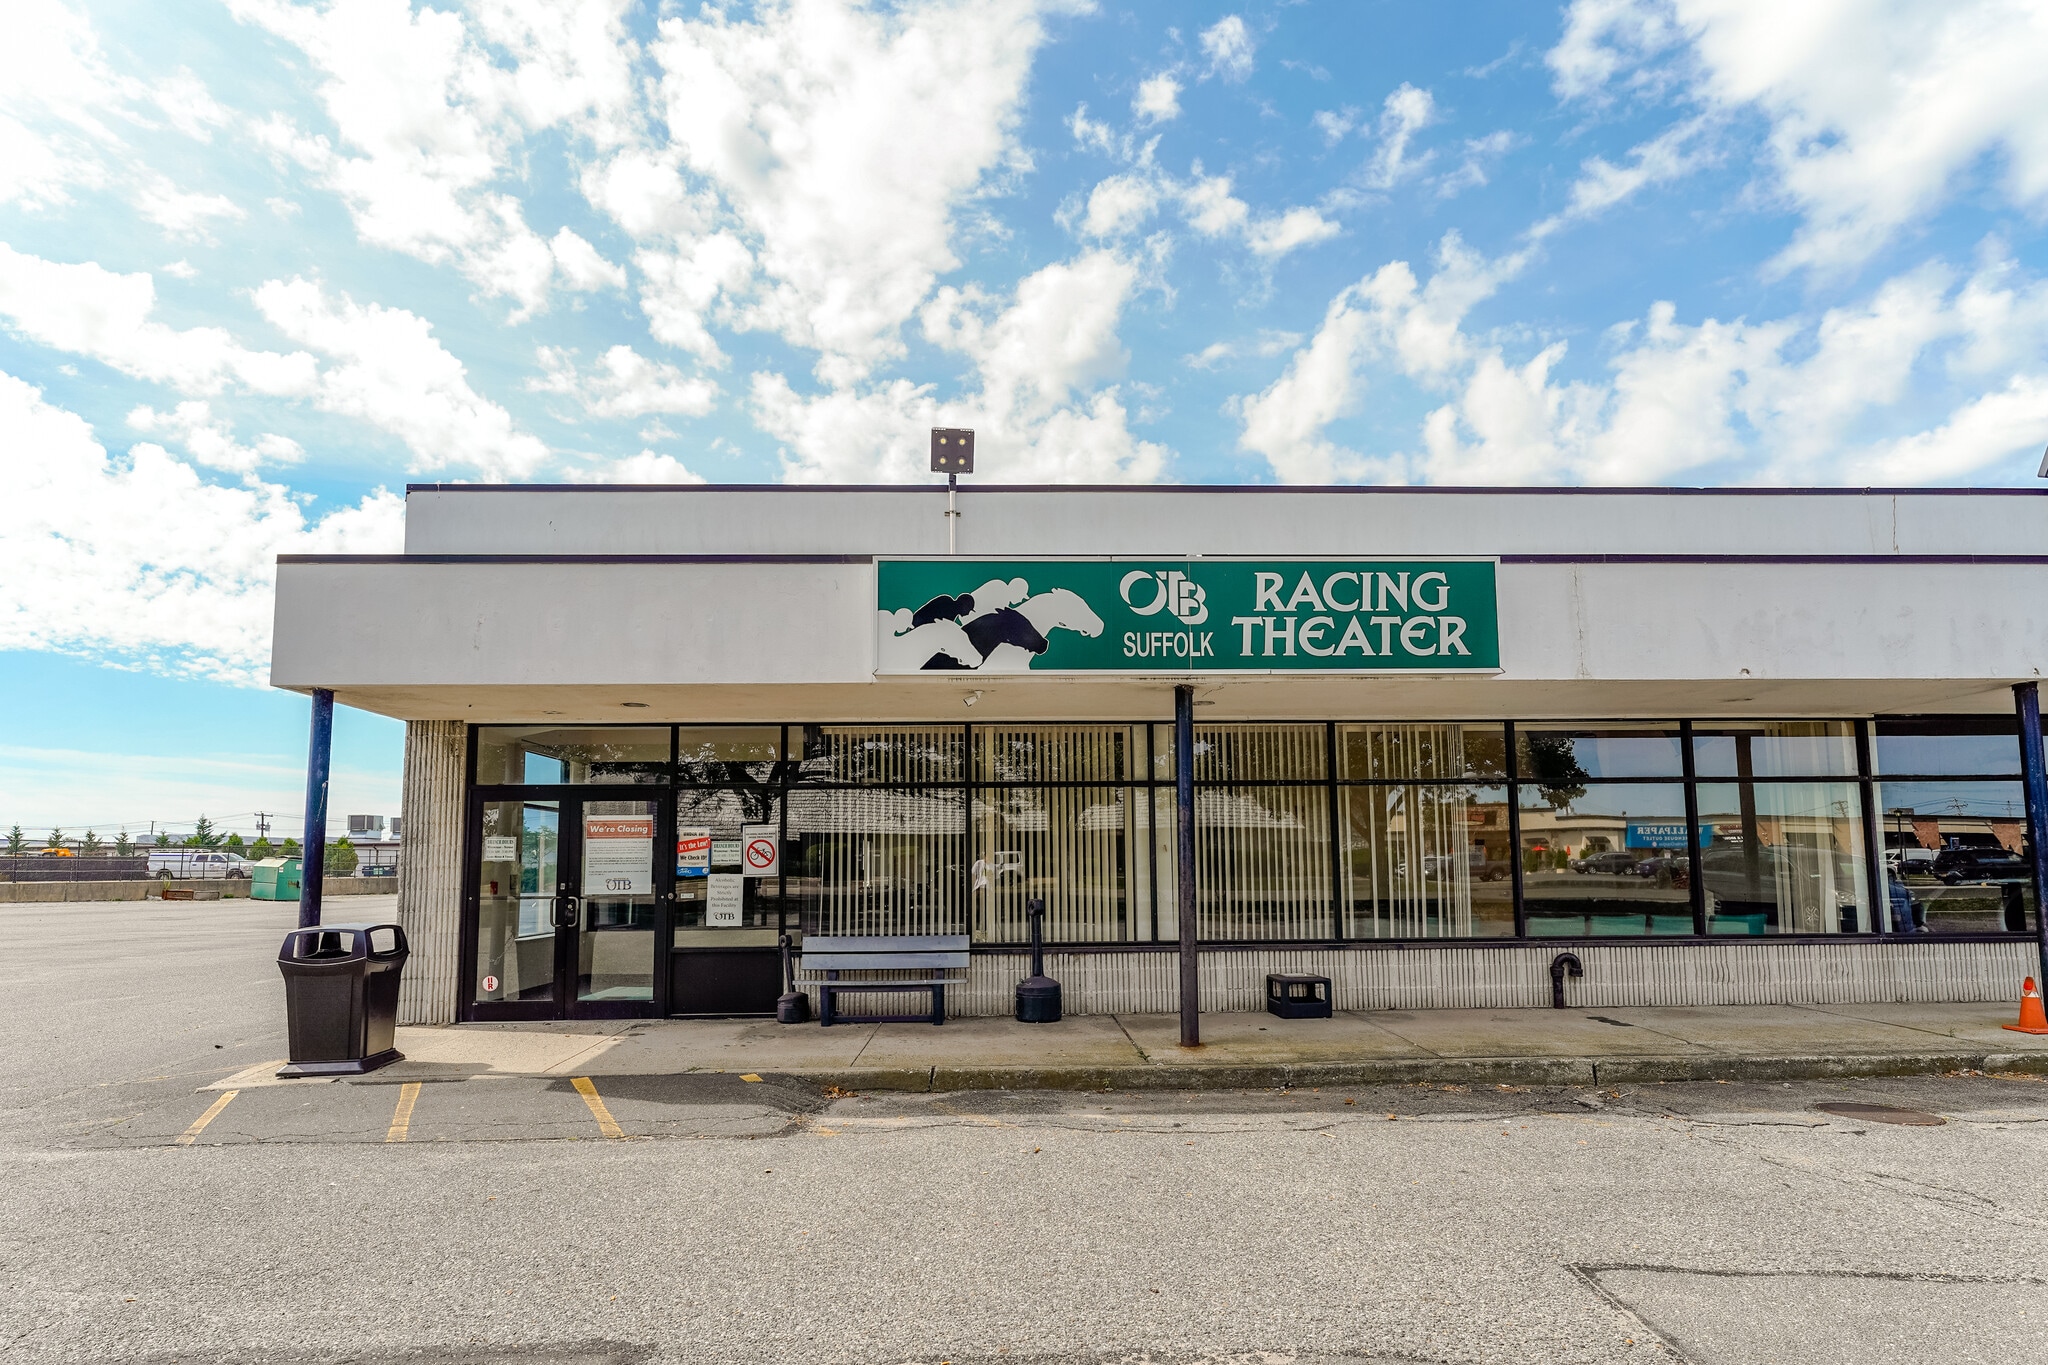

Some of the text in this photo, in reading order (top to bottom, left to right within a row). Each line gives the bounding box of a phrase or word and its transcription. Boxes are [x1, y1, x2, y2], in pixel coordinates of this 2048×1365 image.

[1119, 570, 1208, 625] OTB
[1253, 571, 1450, 612] RACING
[1123, 631, 1215, 658] SUFFOLK
[1231, 615, 1471, 656] THEATER
[590, 825, 648, 834] We're Closing
